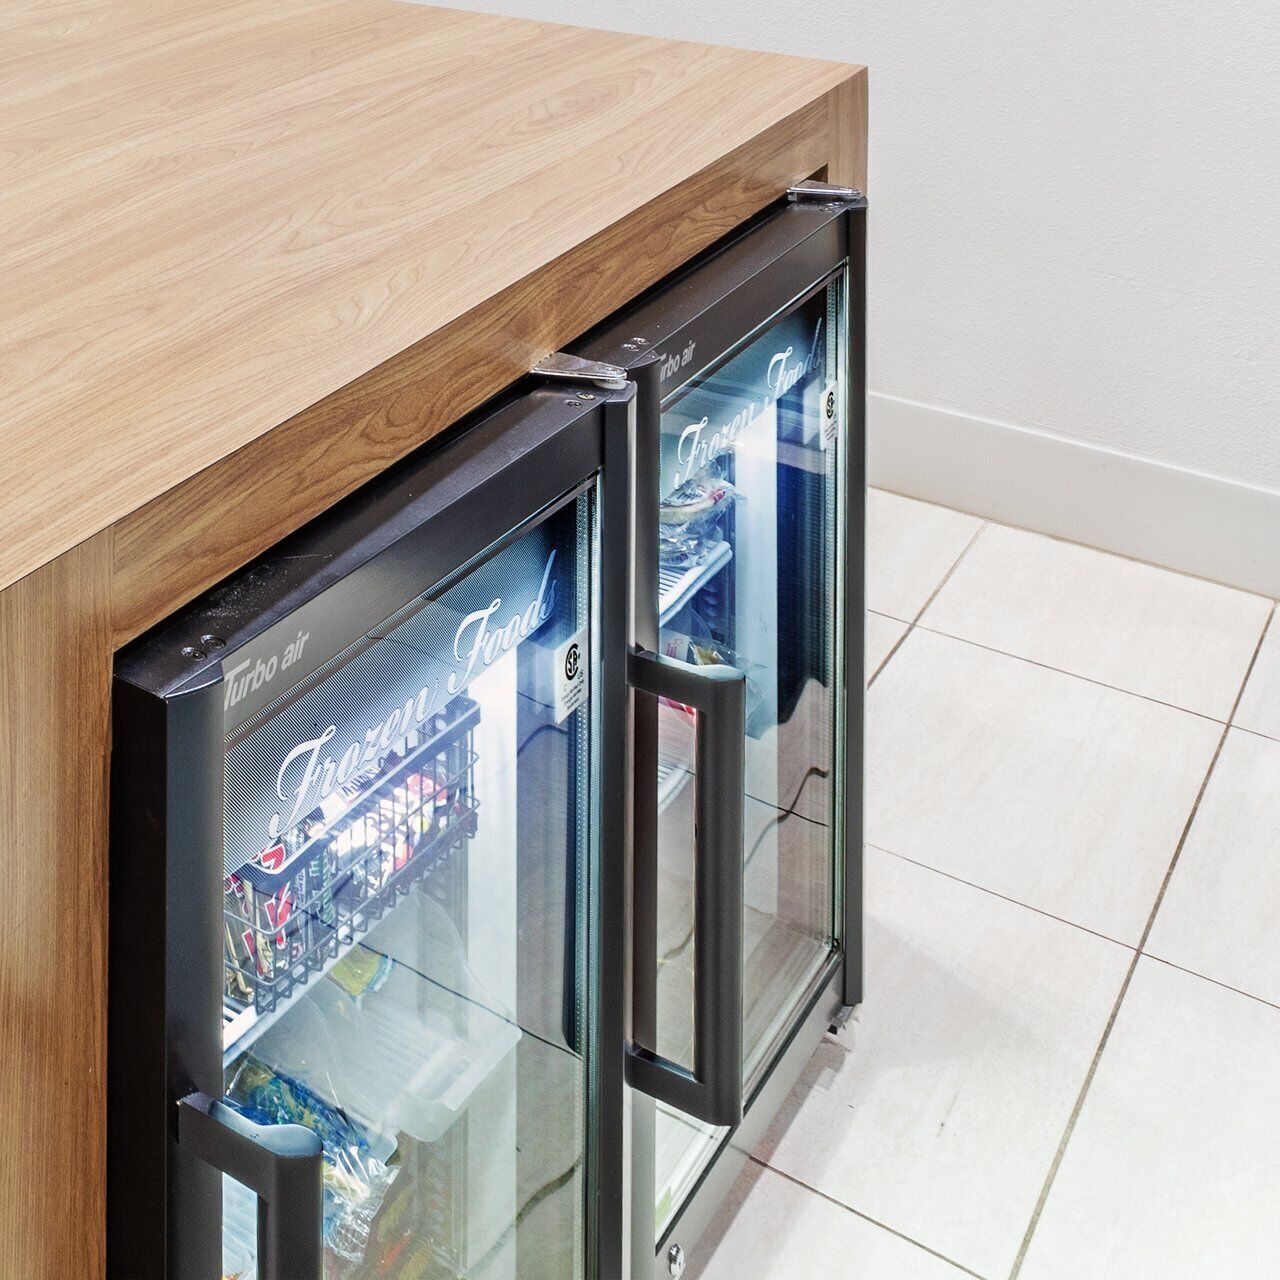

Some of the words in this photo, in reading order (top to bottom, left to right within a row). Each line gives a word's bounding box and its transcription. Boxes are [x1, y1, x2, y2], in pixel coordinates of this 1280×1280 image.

[682, 340, 695, 367] air
[224, 656, 278, 711] Turbo
[281, 631, 310, 671] air
[269, 678, 439, 838] Frozen
[447, 550, 559, 694] Foods
